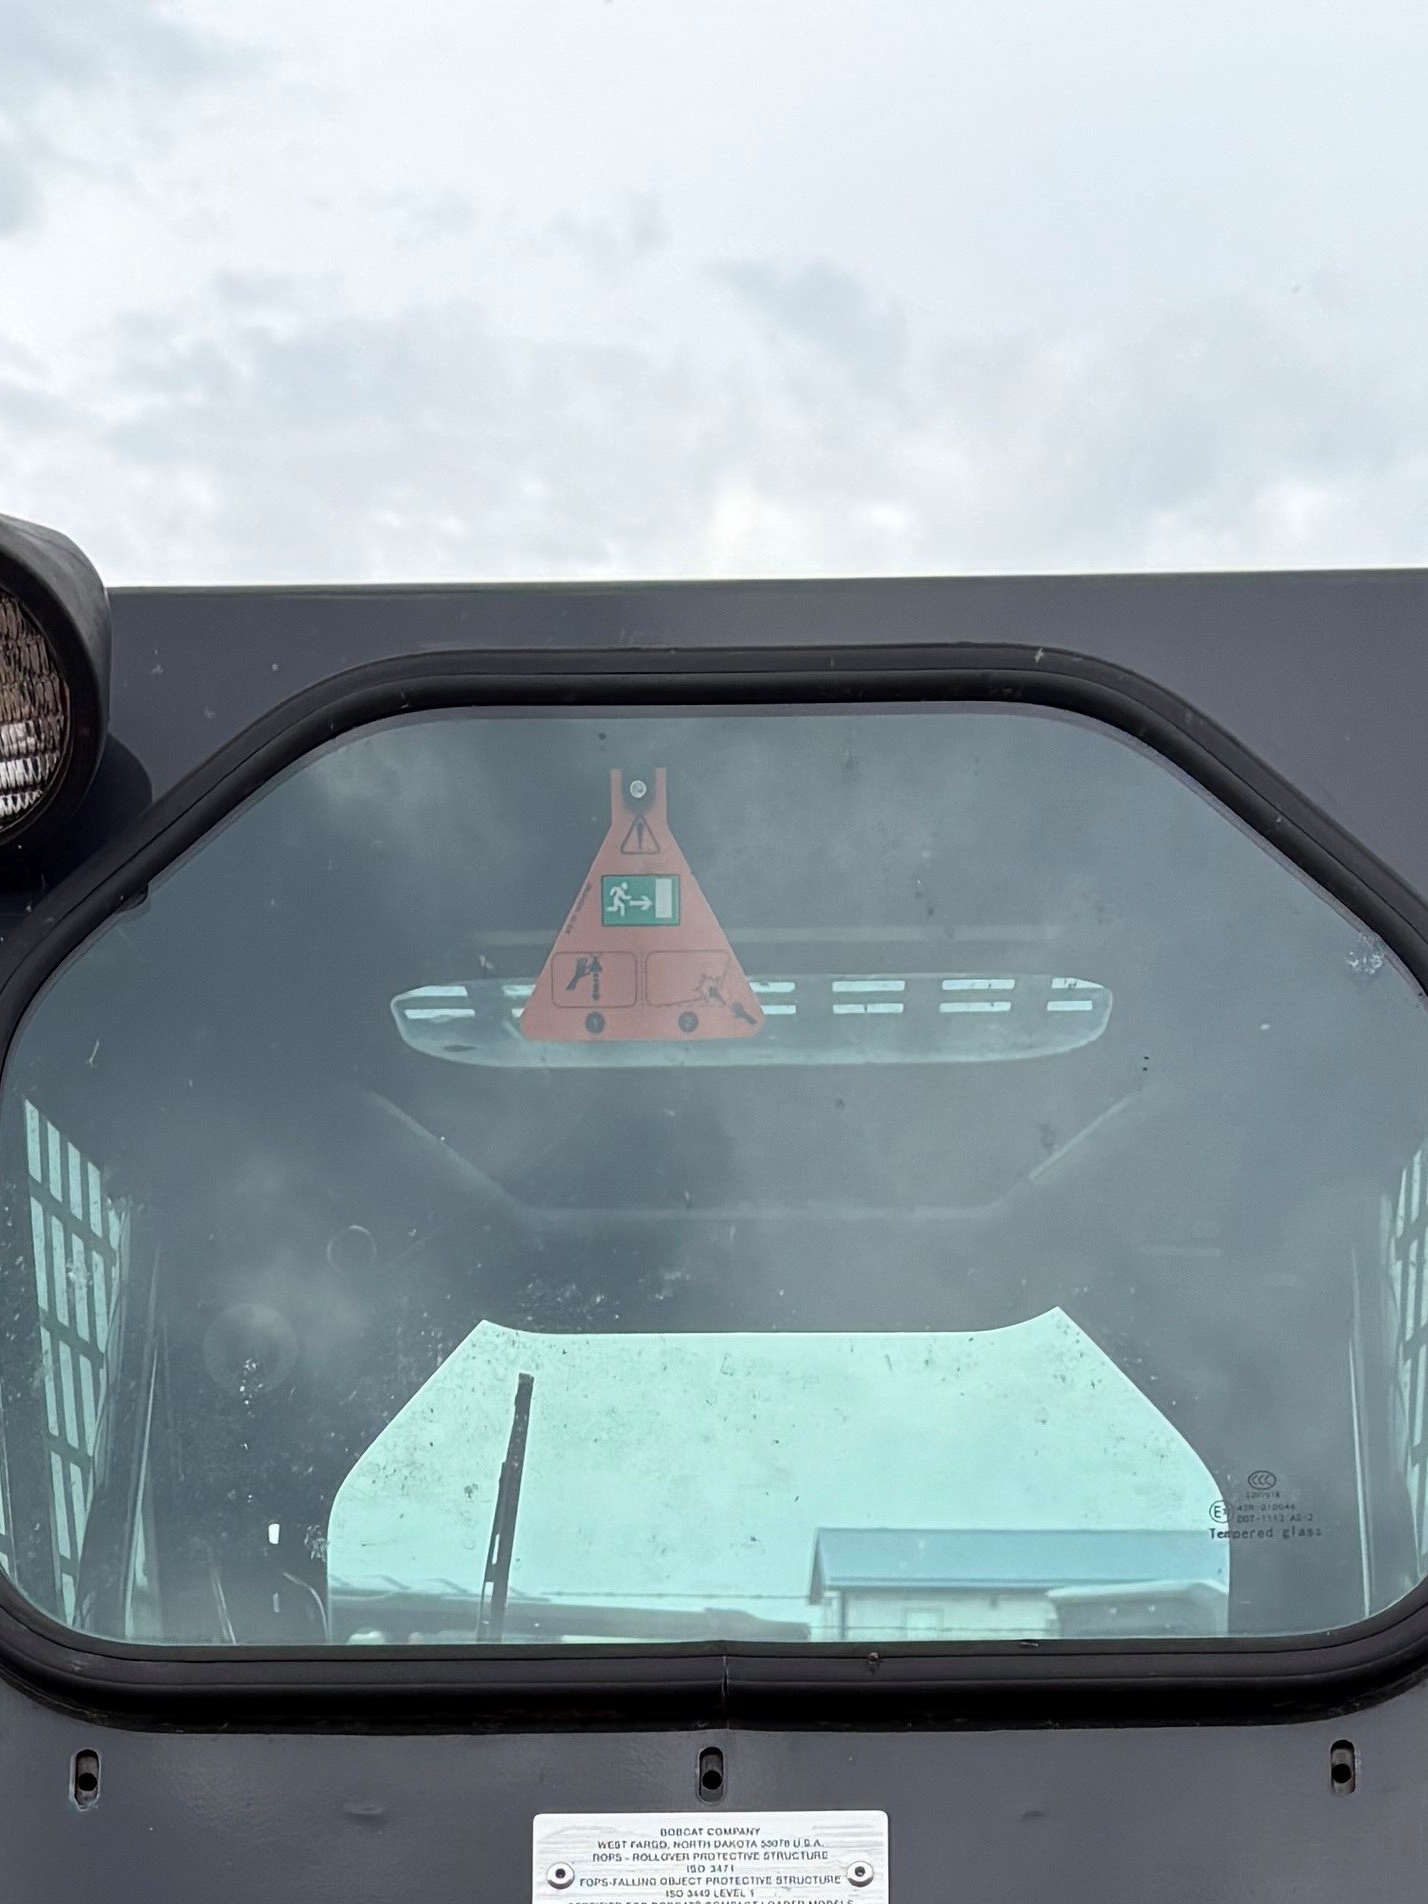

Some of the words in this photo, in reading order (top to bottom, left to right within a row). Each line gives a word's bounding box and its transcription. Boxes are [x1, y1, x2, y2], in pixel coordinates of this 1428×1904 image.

[1209, 1527, 1274, 1540] Tempered
[1282, 1525, 1322, 1540] glass
[660, 1827, 703, 1837] BOBCAT
[706, 1827, 761, 1836] COMPANY
[597, 1840, 627, 1850] WEST
[630, 1840, 670, 1850] FARGO,
[673, 1839, 711, 1849] NORTH
[714, 1839, 758, 1848] DAKOTA
[592, 1853, 622, 1862] ROPS
[632, 1853, 690, 1862] ROLLOVER
[693, 1852, 760, 1861] PROTECTIVE
[763, 1851, 829, 1860] STRUCTURE
[686, 1864, 706, 1873] ISO
[660, 1876, 702, 1886] OBJECT
[706, 1876, 772, 1885] PROTECTIVE
[775, 1875, 841, 1885] STRUCTURE
[665, 1889, 684, 1898] ISO
[713, 1889, 746, 1898] LEVEL
